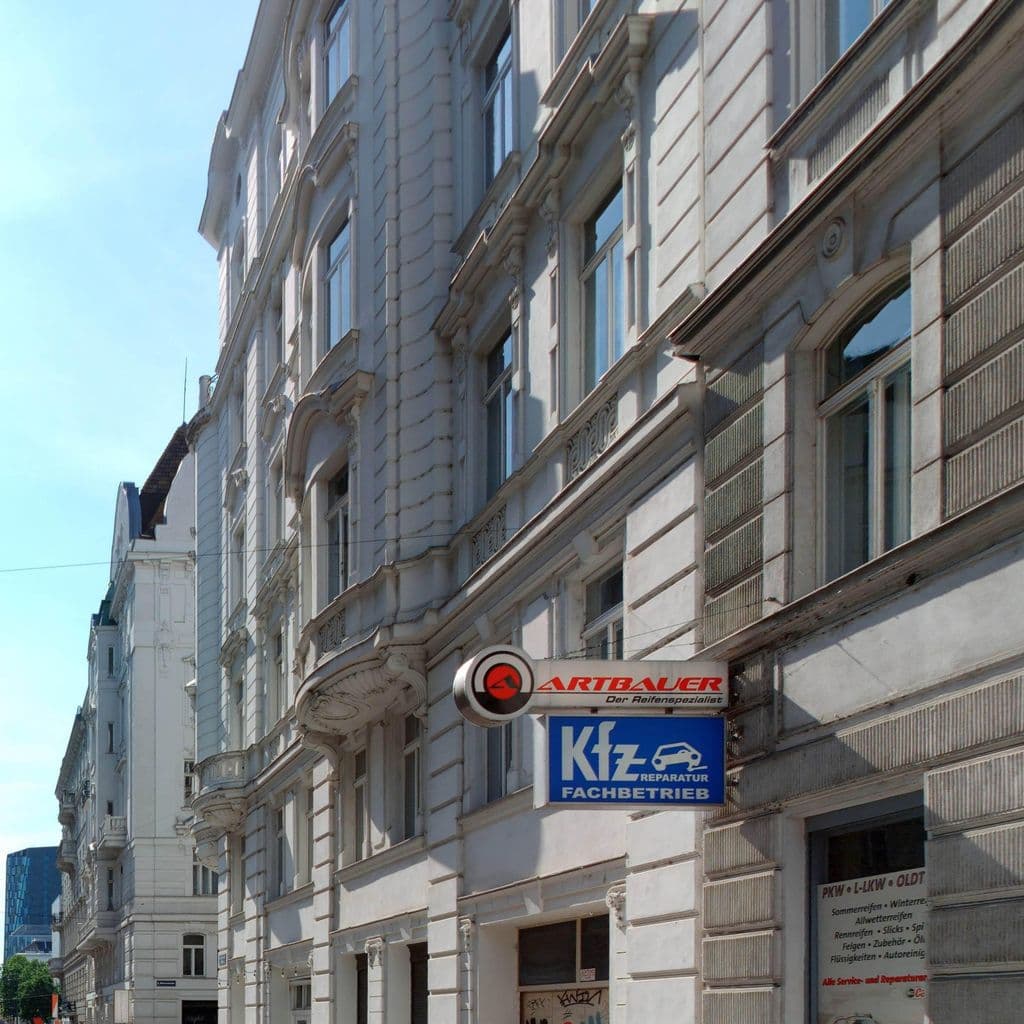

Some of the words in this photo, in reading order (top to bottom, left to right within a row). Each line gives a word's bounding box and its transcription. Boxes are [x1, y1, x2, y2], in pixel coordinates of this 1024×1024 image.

[536, 676, 723, 691] ARTBAUER
[605, 695, 628, 704] Der
[631, 695, 724, 705] Reifenspezialist
[561, 720, 647, 782] Kfz
[640, 773, 709, 783] REPARATUR
[561, 787, 710, 800] FACHBETRIEB
[822, 884, 845, 899] PKW
[831, 903, 882, 916] Sommerreifen
